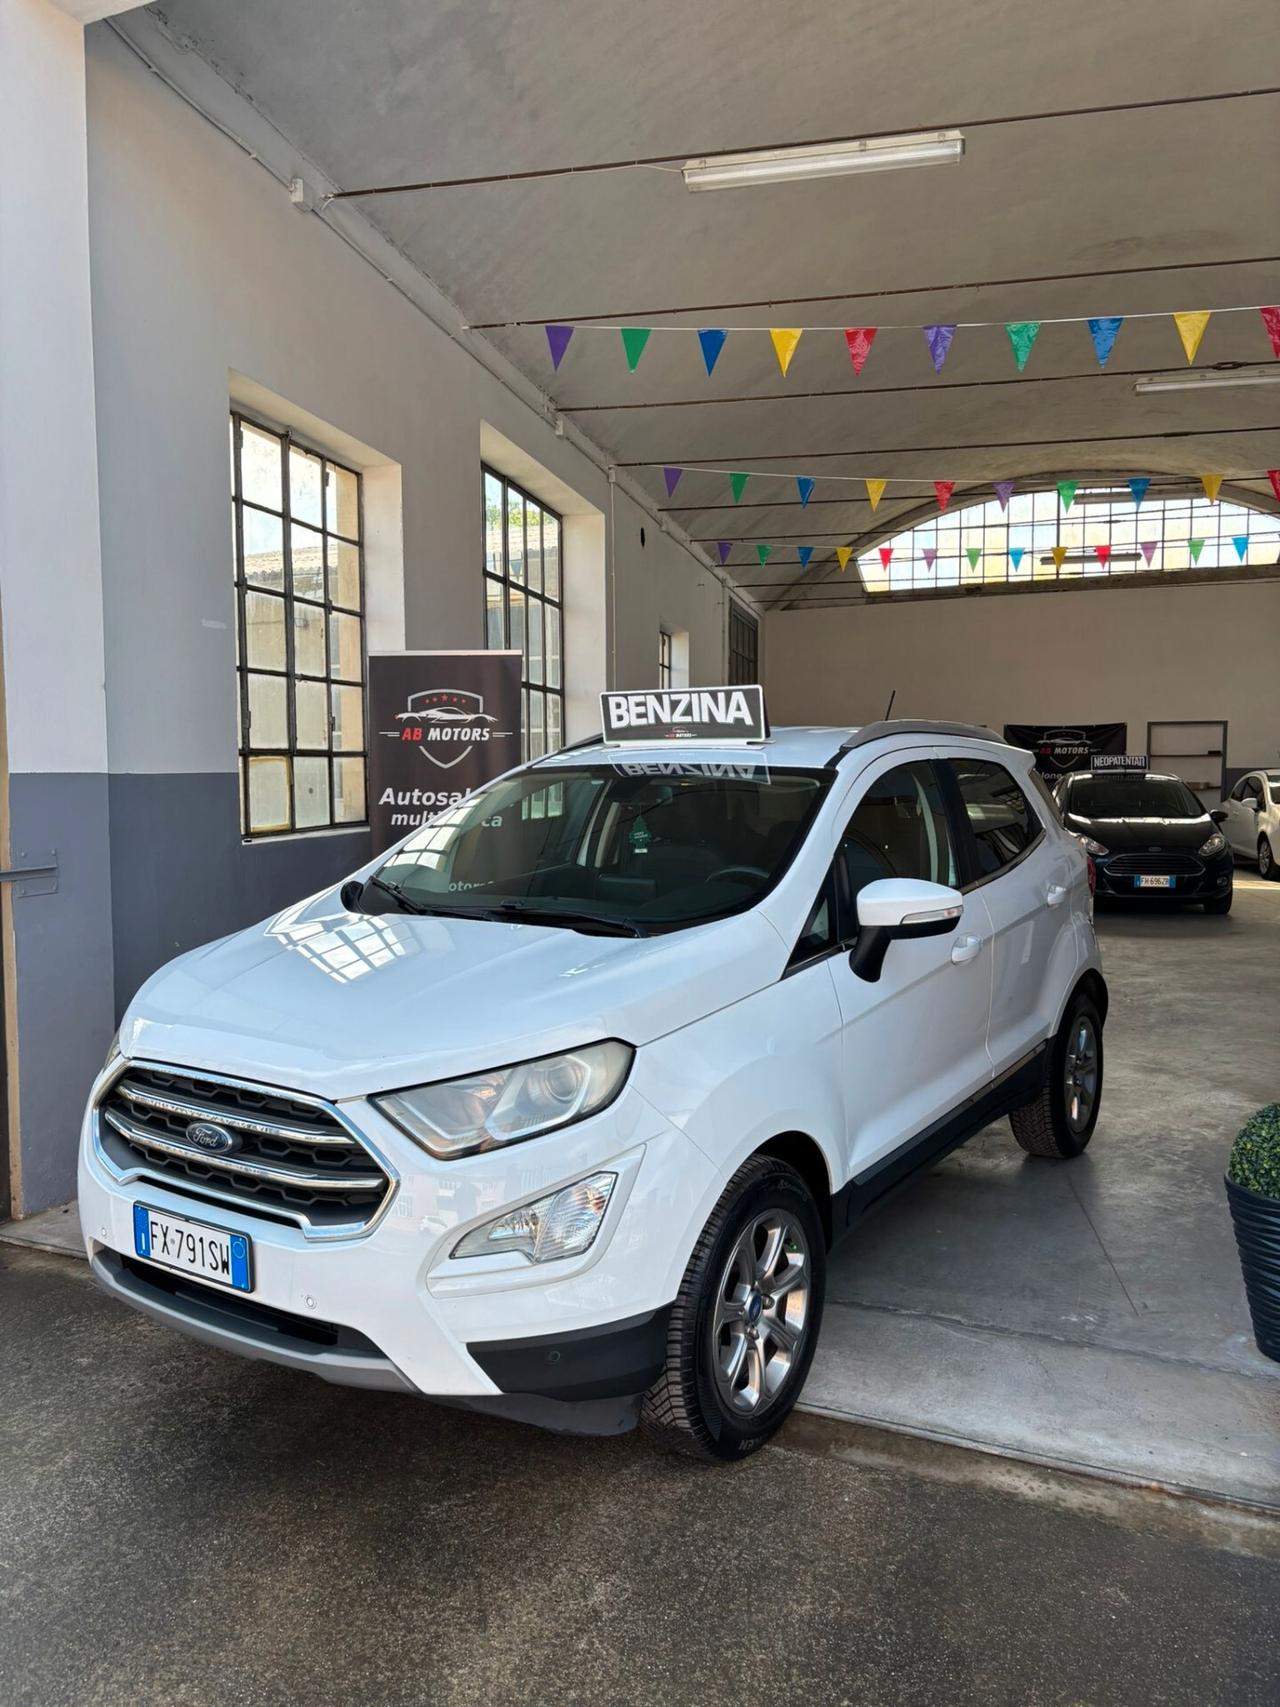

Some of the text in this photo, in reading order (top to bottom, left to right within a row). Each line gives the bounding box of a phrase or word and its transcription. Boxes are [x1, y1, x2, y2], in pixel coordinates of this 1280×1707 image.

[608, 691, 754, 729] BENZINA
[402, 727, 490, 741] AB MOTORS
[1054, 746, 1089, 755] MOTORS
[193, 1127, 219, 1147] Ford
